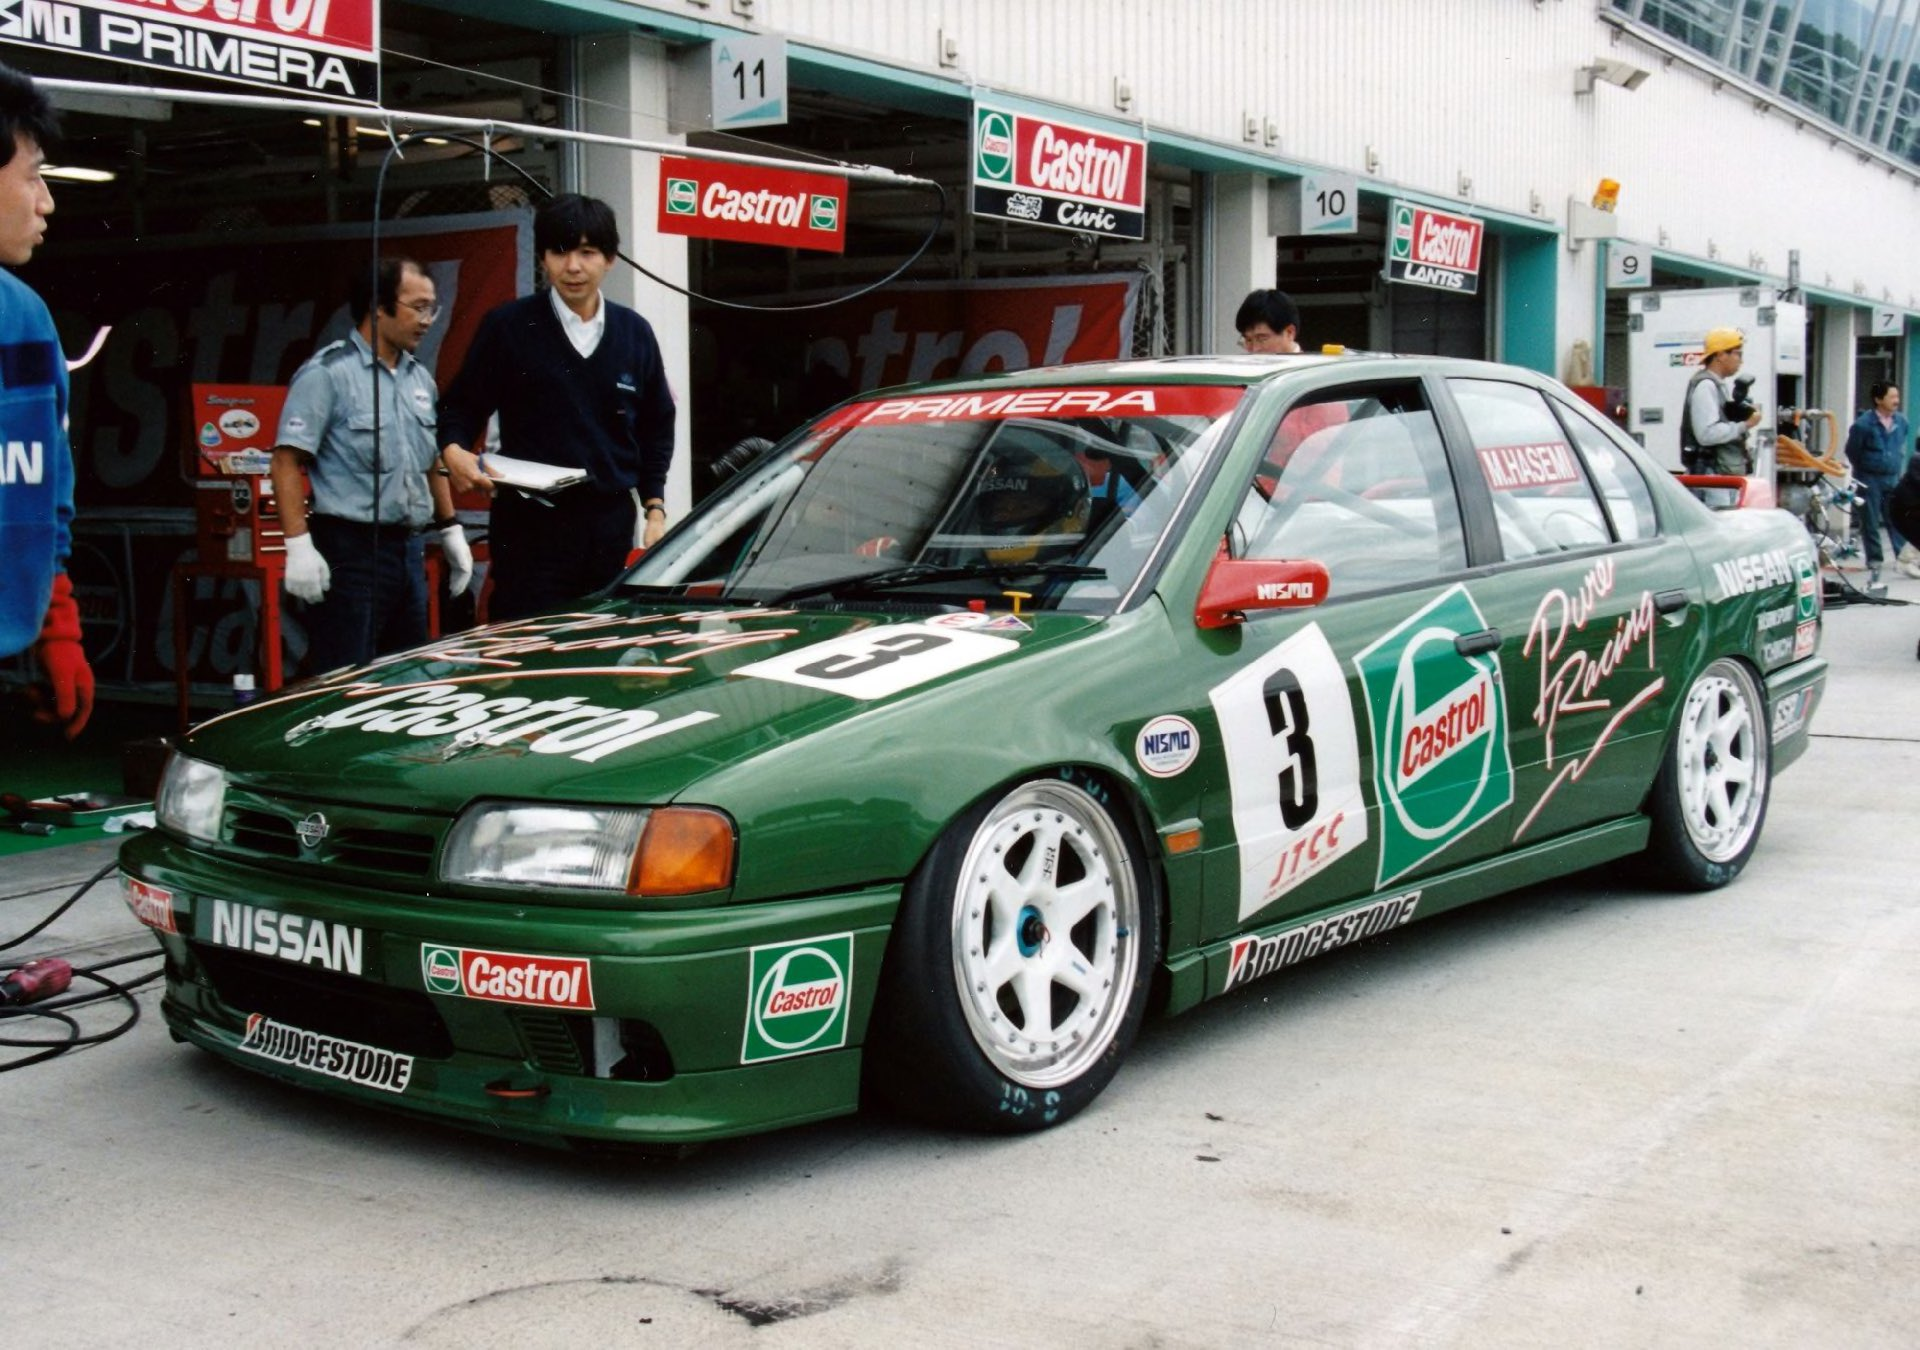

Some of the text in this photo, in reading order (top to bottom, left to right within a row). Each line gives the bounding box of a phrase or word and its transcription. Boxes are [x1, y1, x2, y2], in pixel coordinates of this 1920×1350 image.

[100, 14, 356, 95] PRIMERA
[718, 46, 732, 62] A
[733, 58, 765, 100] 11
[1030, 124, 1132, 201] Castrol
[702, 181, 806, 228] Castrol
[1057, 201, 1117, 231] Civic
[1317, 190, 1345, 216] 10
[1418, 213, 1476, 268] Castrol
[1404, 263, 1465, 289] LANTIS
[1622, 255, 1639, 275] 9
[1882, 313, 1895, 328] 7
[860, 390, 1157, 423] PRIMERA
[1257, 582, 1313, 600] NISMO
[1712, 549, 1794, 599] NISSAN
[794, 633, 954, 679] 3
[1523, 557, 1615, 727] Pure
[1533, 589, 1656, 771] Racing
[322, 684, 721, 763] Castrol
[1144, 730, 1191, 755] NISMO
[1401, 681, 1486, 777] Castrol
[1263, 667, 1318, 831] 3
[1269, 812, 1345, 889] JTCC
[212, 899, 363, 976] NISSAN
[1227, 893, 1420, 990] BRIDGESTONE
[468, 956, 583, 1003] Castrol
[769, 982, 838, 1014] Castrol
[244, 1013, 412, 1091] BRIDGESTONE
